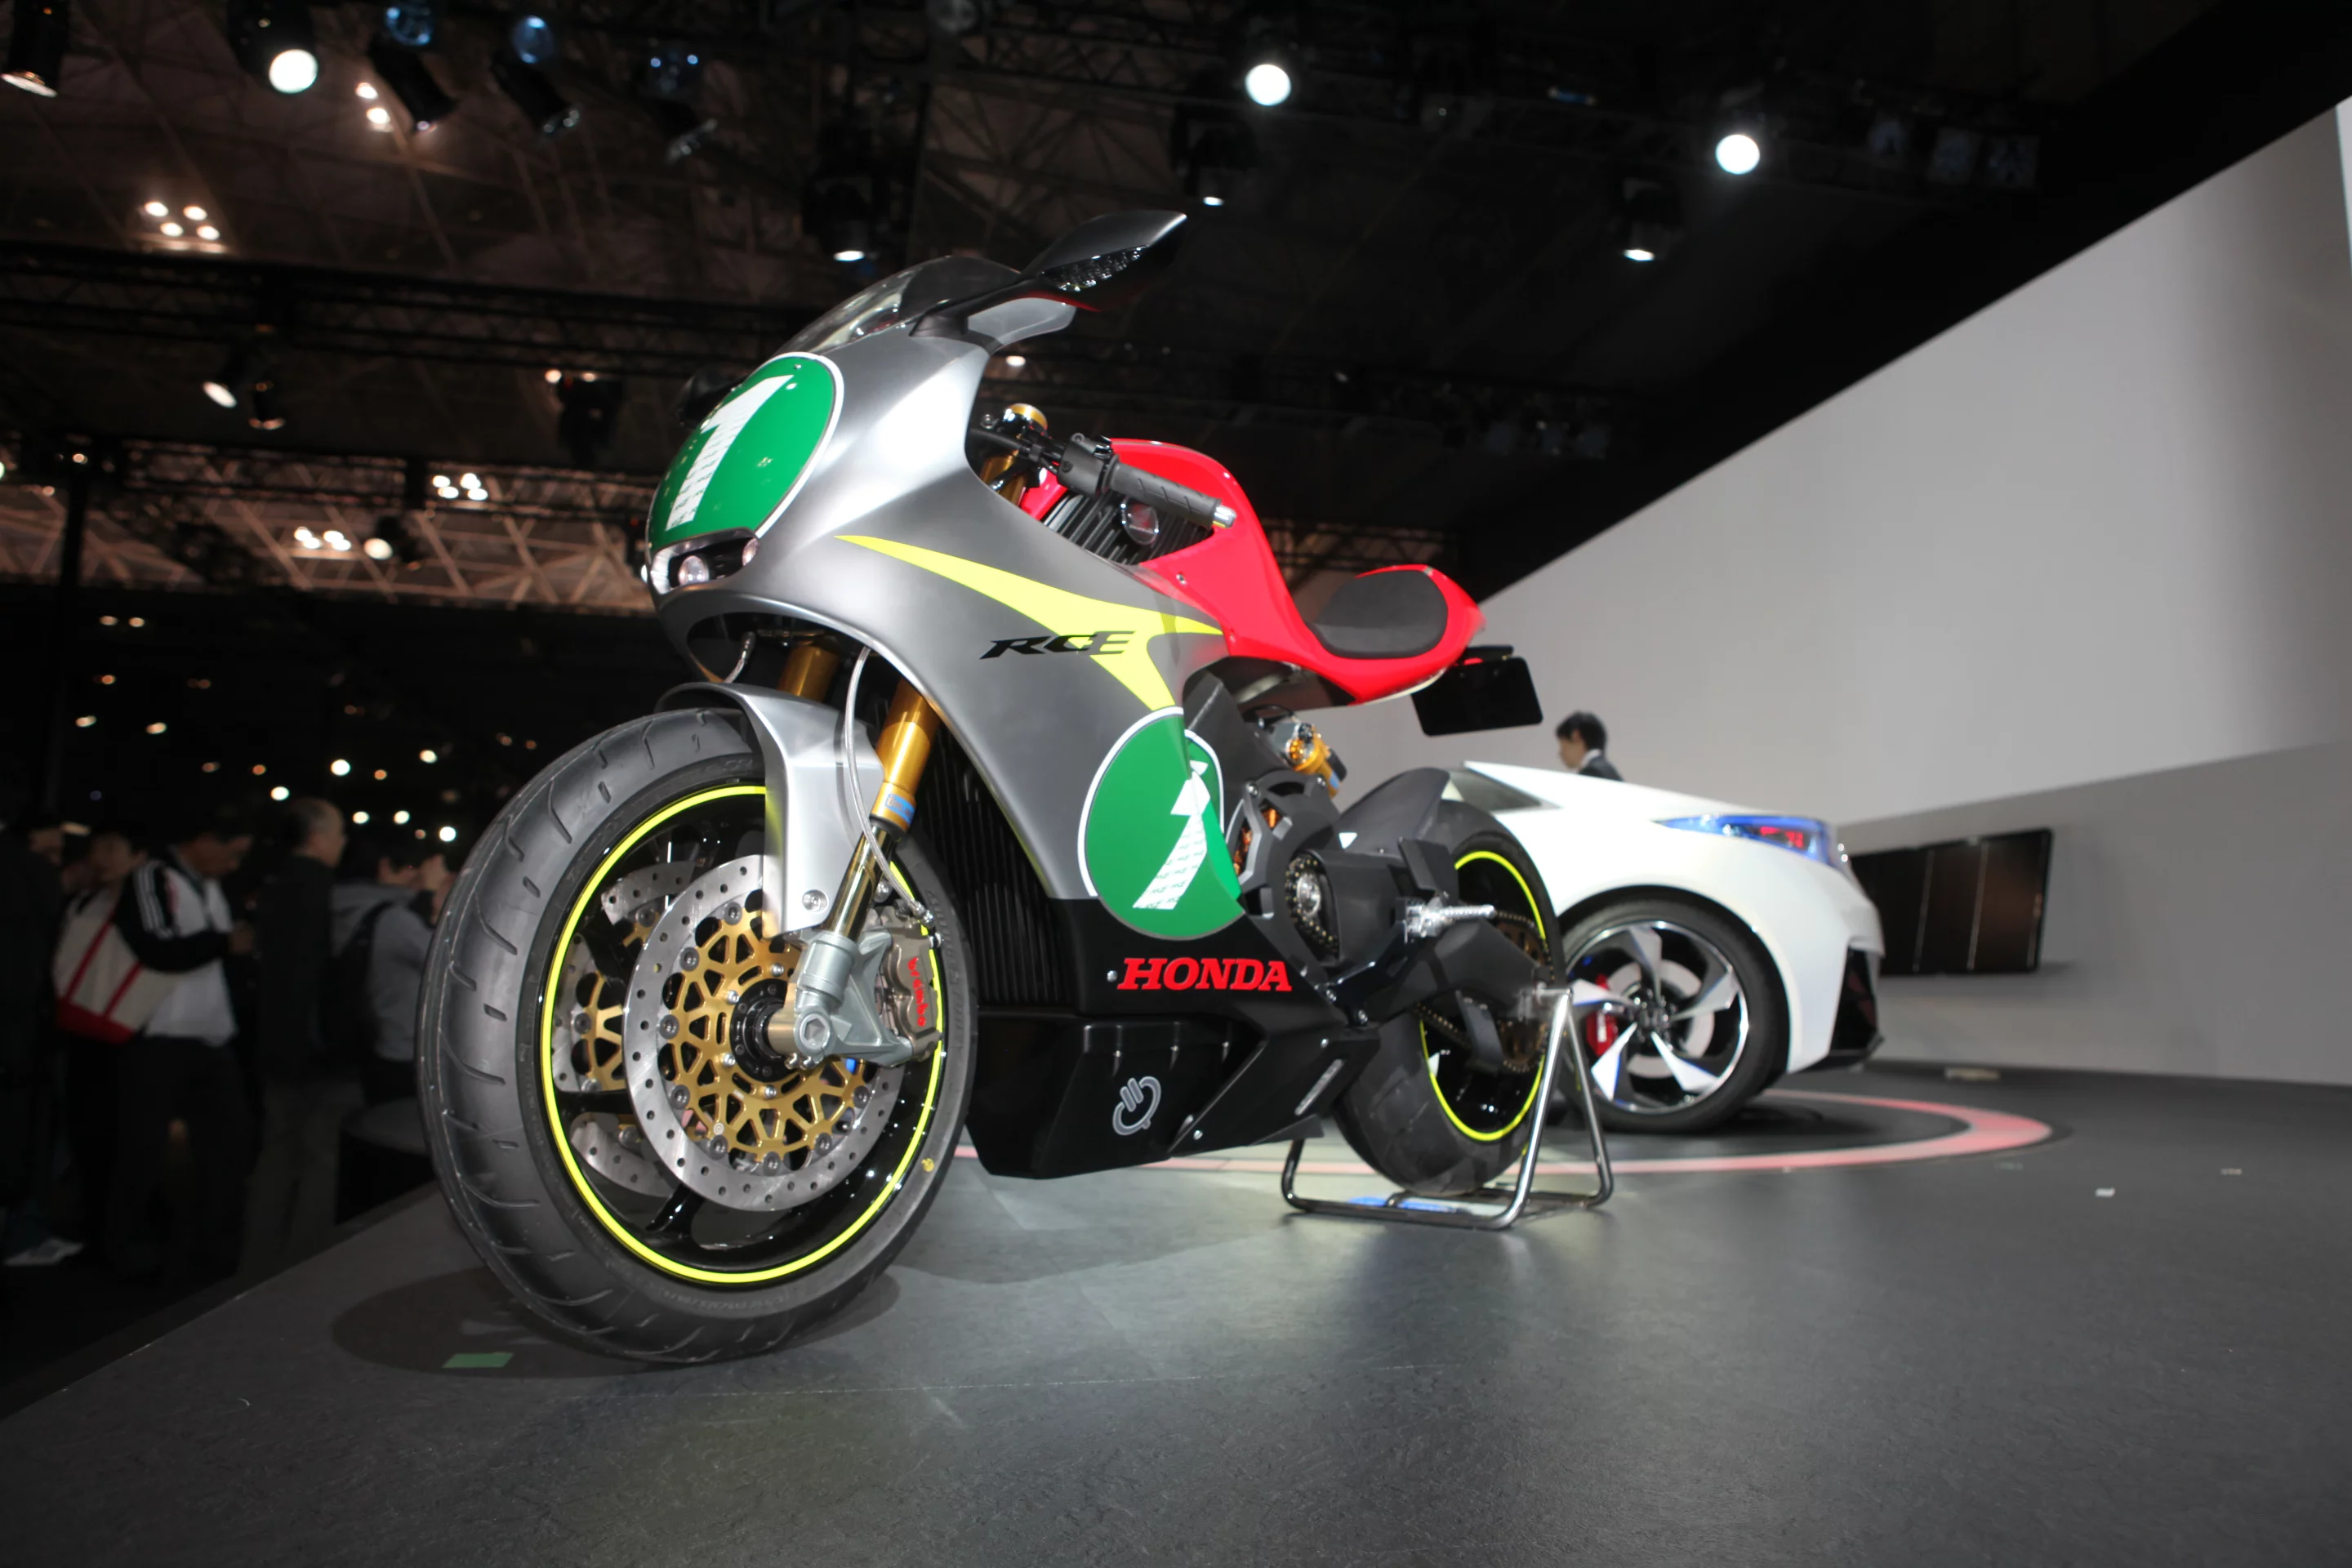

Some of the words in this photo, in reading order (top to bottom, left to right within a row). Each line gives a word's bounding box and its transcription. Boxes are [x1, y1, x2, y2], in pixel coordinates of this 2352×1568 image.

[666, 375, 793, 531] 1
[980, 631, 1136, 660] RCE
[1133, 760, 1209, 910] 1
[907, 957, 929, 1027] brembo
[1117, 958, 1292, 991] HONDA
